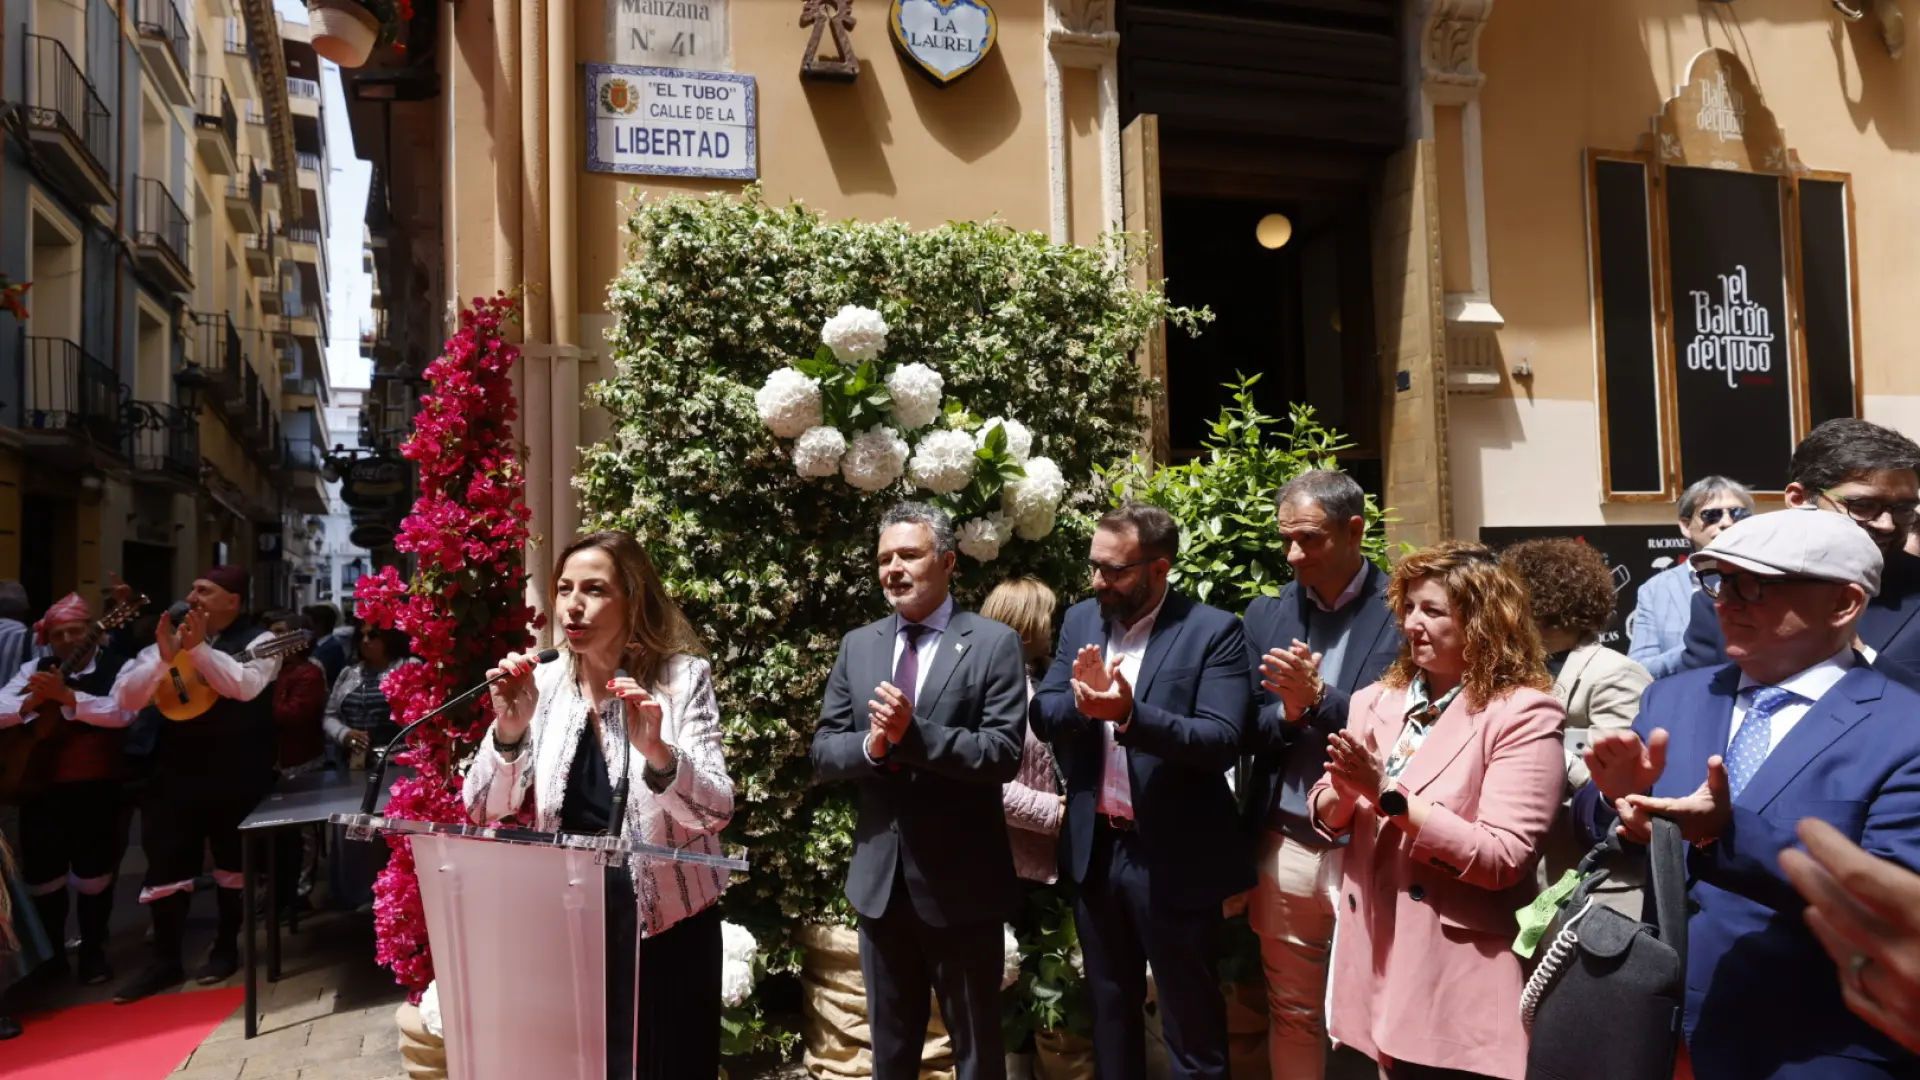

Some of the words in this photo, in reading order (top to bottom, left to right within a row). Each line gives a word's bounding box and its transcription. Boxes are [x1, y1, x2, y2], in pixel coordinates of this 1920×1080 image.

[621, 0, 710, 21] Manzana
[933, 17, 958, 34] LA
[670, 32, 696, 57] 41
[911, 32, 978, 53] LAUREL
[650, 103, 692, 119] CALLE
[696, 106, 714, 120] DE
[718, 108, 736, 122] LA
[615, 126, 730, 159] LIBERTAD
[1728, 265, 1753, 305] el
[1689, 274, 1769, 336] Balcón
